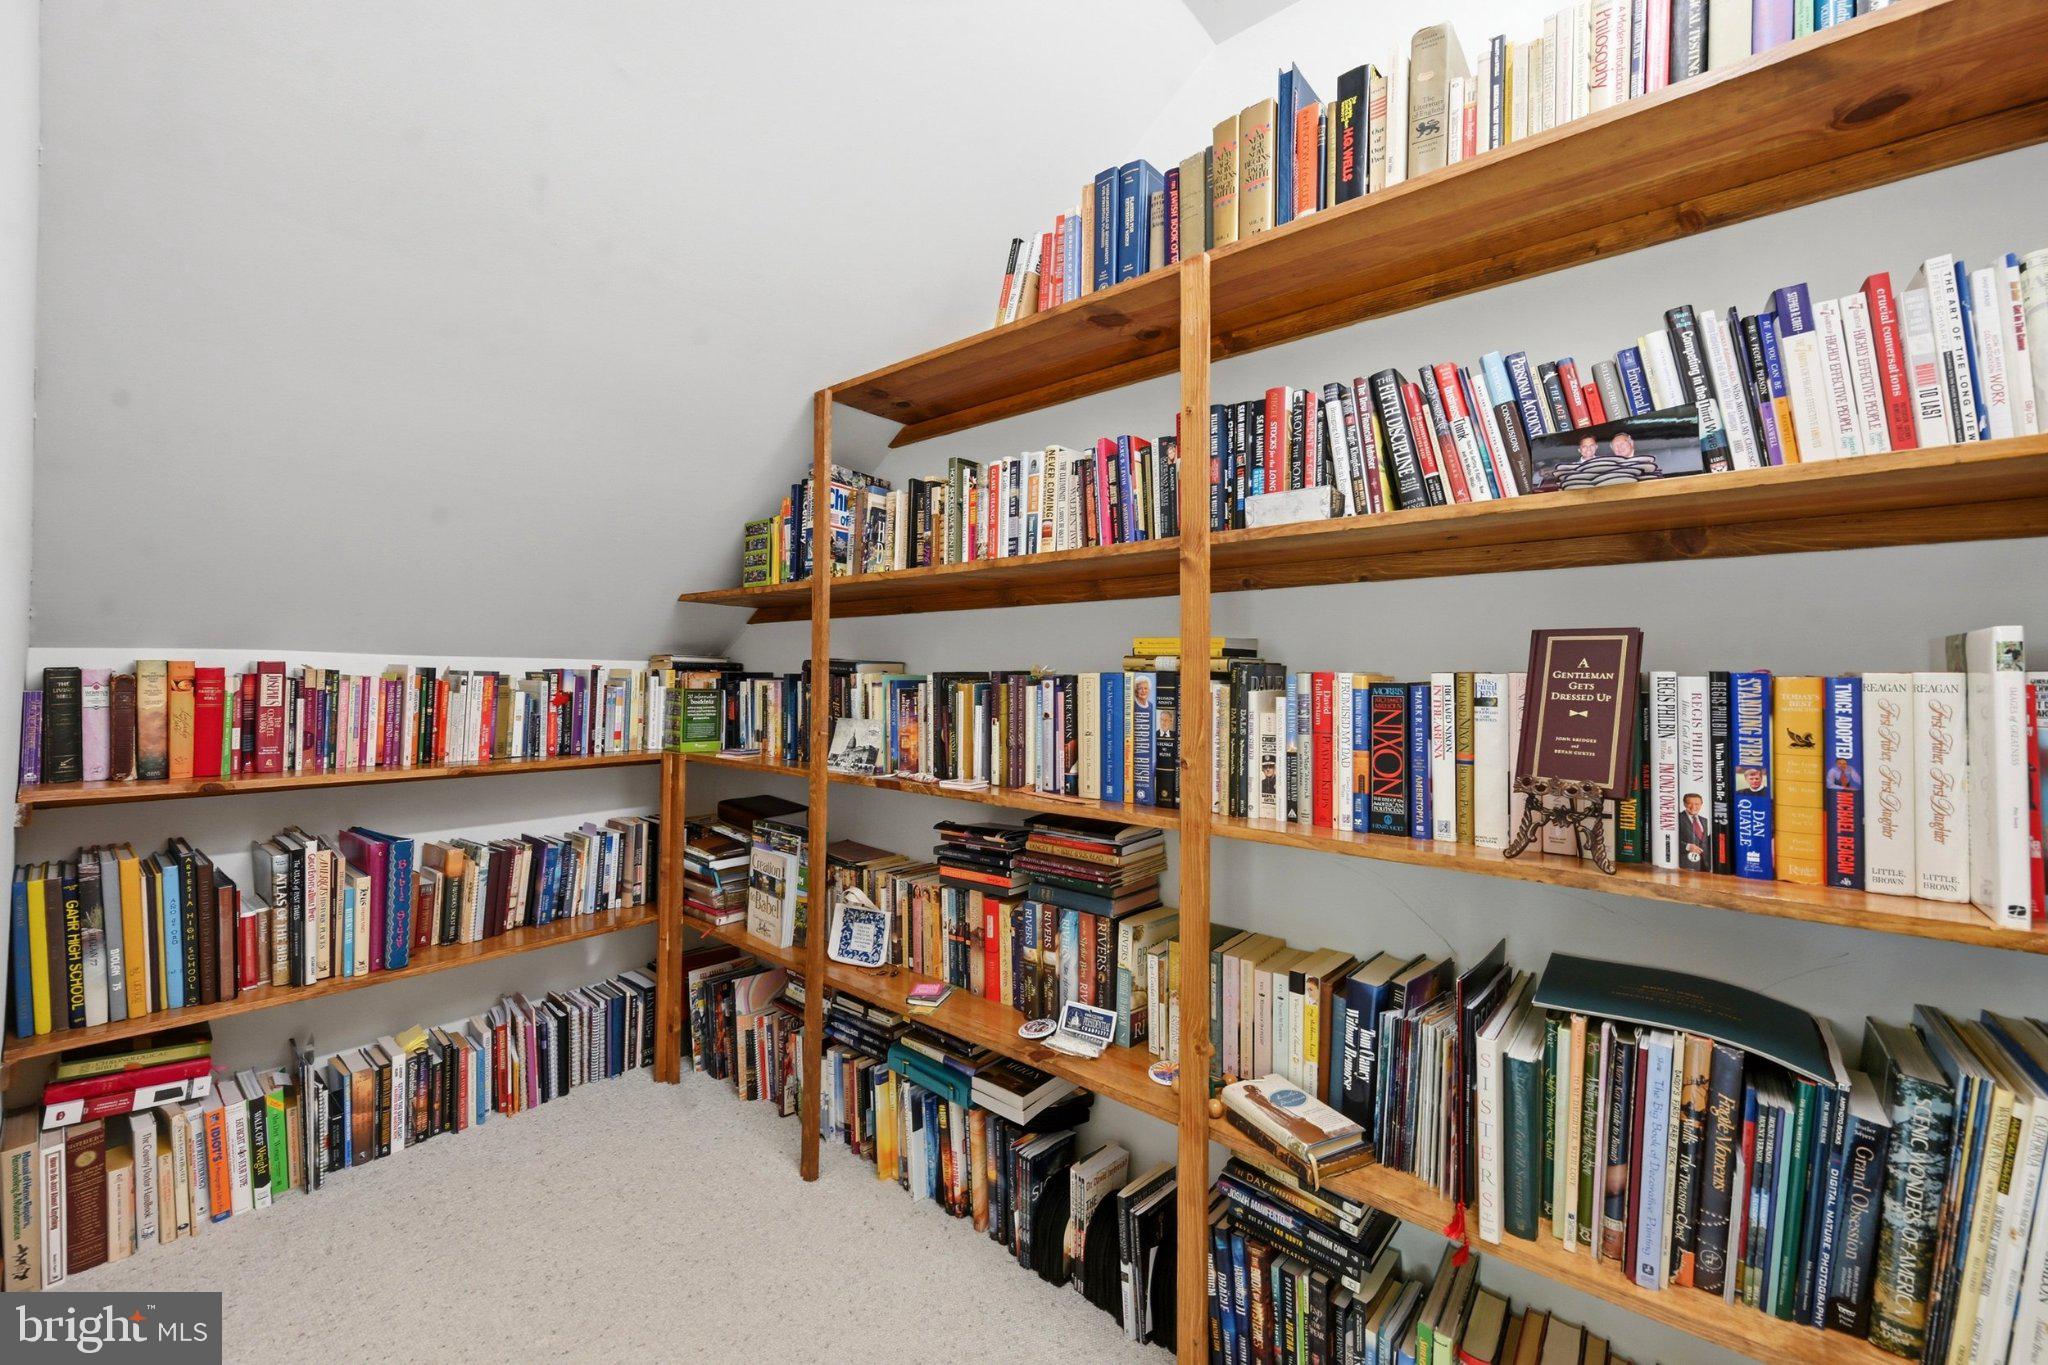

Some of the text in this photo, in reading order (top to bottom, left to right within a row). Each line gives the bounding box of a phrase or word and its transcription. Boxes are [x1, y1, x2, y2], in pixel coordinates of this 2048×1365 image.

[1592, 8, 1612, 89] Philosophy
[1341, 148, 1352, 182] WELLS
[1170, 218, 1178, 241] BOOK
[1171, 243, 1178, 252] OF
[1943, 271, 1955, 293] THE
[1947, 299, 1959, 320] ART
[1875, 287, 1904, 396] crucial conversations
[1951, 325, 1962, 341] OF
[1750, 343, 1763, 367] PEOPLE
[1955, 346, 1966, 368] THE
[1507, 355, 1536, 398] PERSONAL
[1548, 383, 1561, 401] THE
[1679, 330, 1720, 449] Competing in the Third Wave
[1823, 334, 1852, 433] HIGHLY EFFECTIVE PEOPLE
[1851, 328, 1882, 429] HIGHLY EFFECTIVE PEOPLE
[1958, 374, 1971, 406] LONG
[1988, 372, 2005, 405] WORK
[1918, 387, 1942, 419] TO LAST
[1254, 414, 1264, 466] SEAN HANNITY
[1268, 421, 1277, 448] STOCKS
[1293, 408, 1301, 441] ABOVE
[1377, 382, 1415, 476] FIFTH DISCIPLINE
[1452, 417, 1470, 442] Think
[1499, 403, 1520, 452] CONCLUSIONS
[1965, 412, 1976, 440] VIEW
[1349, 447, 1361, 477] Kingdom
[1044, 449, 1056, 517] NEVER COMING
[1552, 670, 1614, 681] GENTLEMAN
[1577, 657, 1590, 669] A
[1064, 682, 1072, 709] NEVER
[1323, 690, 1331, 714] David
[1372, 686, 1404, 696] MORRIS
[1551, 692, 1612, 703] DRESSED UP
[1568, 681, 1595, 691] GETS
[1863, 682, 1907, 694] REAGAN
[1914, 683, 1959, 694] REAGAN
[1414, 716, 1422, 724] R.
[1458, 676, 1470, 752] RICHARD NIXON
[1656, 676, 1675, 738] REGIS PHILBIN
[1711, 681, 1726, 736] REGIS PHILBIN
[1789, 700, 1811, 708] BEST
[1433, 684, 1442, 758] IN THE ARENA
[1735, 678, 1763, 767] STANDING FIRM
[1834, 684, 1852, 759] TWICE ADOPTED
[1133, 712, 1149, 782] BARBARA BUSH
[1373, 709, 1403, 797] NIXON
[1414, 727, 1422, 751] LEVIN
[1444, 725, 1452, 752] NIXON
[1690, 692, 1705, 783] REGIS PHILBIN
[1715, 743, 1724, 760] Who
[1659, 775, 1676, 809] ONLY ONE
[1737, 798, 1751, 847] QUAYLE
[1752, 810, 1765, 837] DAN
[1836, 791, 1854, 875] MICHAEL REAGAN
[1872, 866, 1905, 877] LITTLE,
[1872, 876, 1905, 886] BROWN
[1923, 873, 1960, 884] LITTLE,
[1924, 883, 1958, 893] BROWN
[275, 872, 288, 971] ATLAS OF THE BIBLE
[1024, 908, 1033, 945] RIVERS
[65, 899, 84, 1010] GAHR HIGH SCHOOL
[1061, 919, 1070, 958] RIVERS
[1096, 923, 1107, 970] RIVERS
[1121, 929, 1129, 961] RIVERS
[1341, 1008, 1359, 1090] Without Remorse
[1355, 1028, 1375, 1083] Tom Clancy
[1615, 1047, 1624, 1062] The
[1611, 1102, 1622, 1125] Guide
[254, 1110, 268, 1175] WALK OFF Weight
[1480, 1055, 1496, 1209] SISTERS
[1708, 1094, 1738, 1192] Fragile Moments
[1835, 1124, 1843, 1144] BOOKS
[141, 1132, 152, 1167] The Country
[1608, 1136, 1620, 1164] Beauty
[1244, 1172, 1267, 1189] DAY
[1643, 1080, 1664, 1256] The Big Book of Decorative Painting
[1227, 1188, 1251, 1206] JOSIAH
[1674, 1153, 1697, 1242] The Treasure Chest
[1844, 1146, 1875, 1260] Grand Obsession
[1893, 1097, 1932, 1316] SCENIC WONDERS OF AMERICA
[1306, 1230, 1334, 1249] JONATHAN
[1814, 1168, 1838, 1326] DIGITAL NATURE PHOTOGRAPHY
